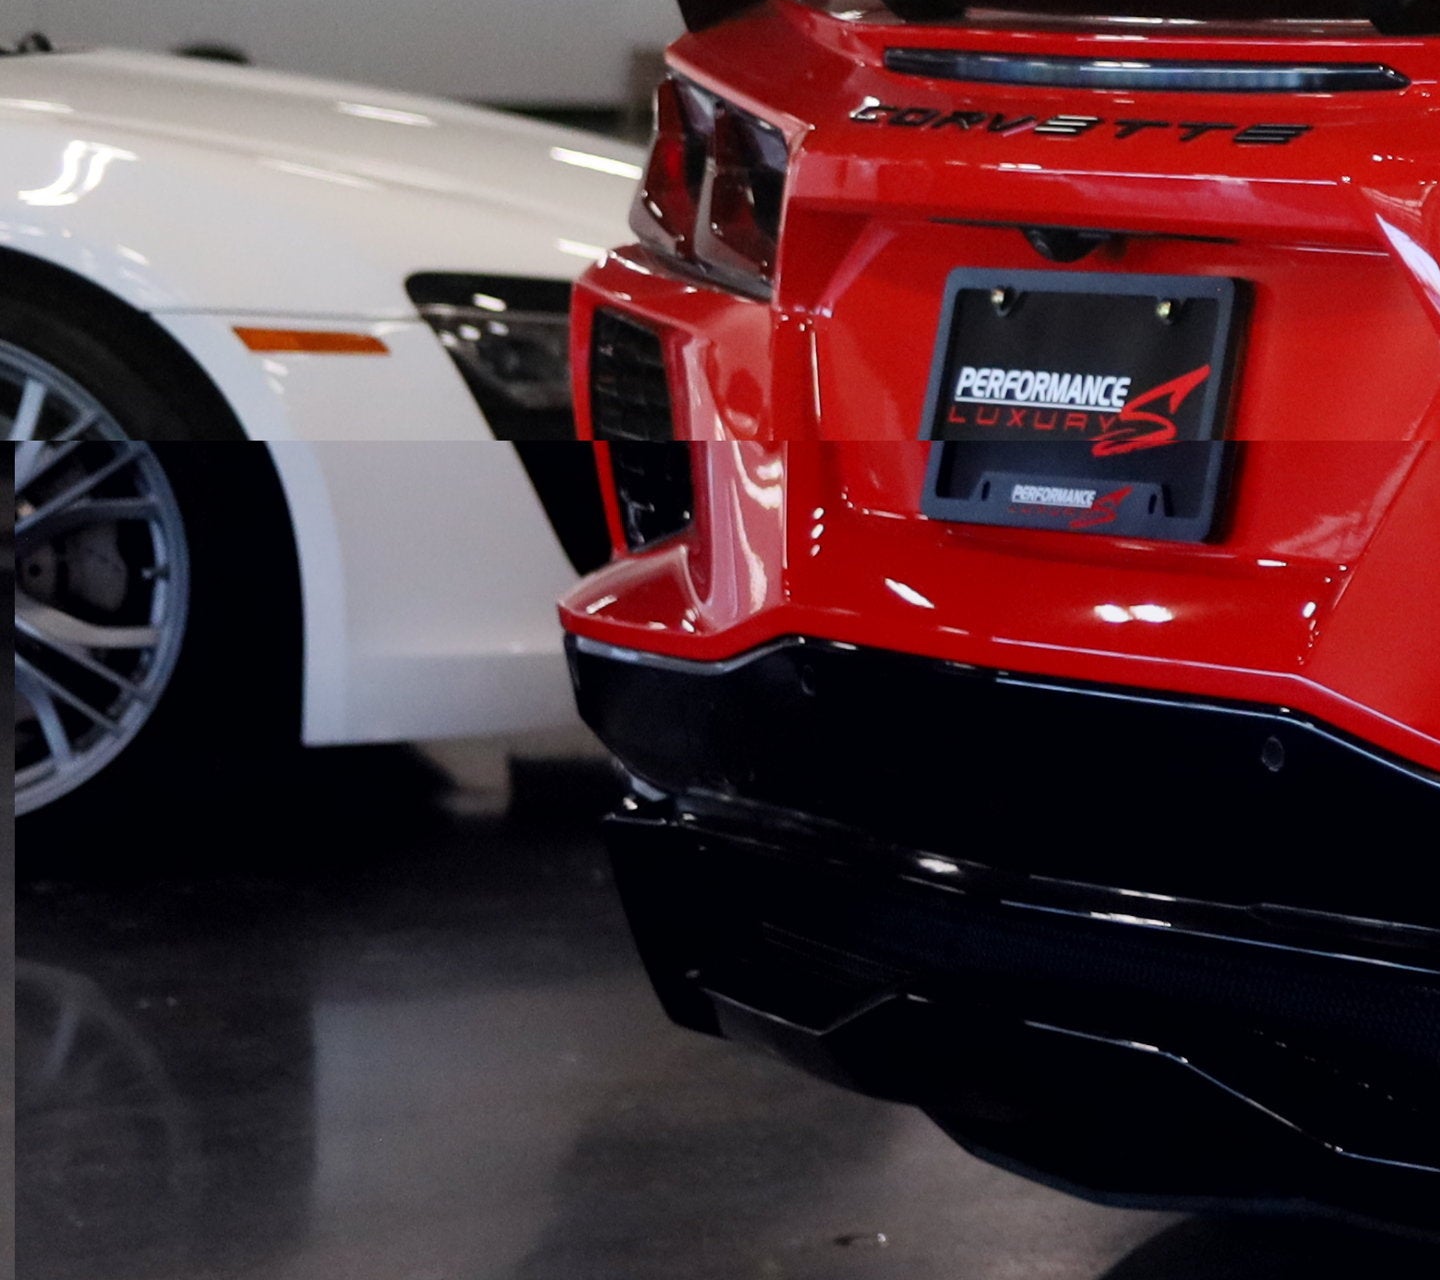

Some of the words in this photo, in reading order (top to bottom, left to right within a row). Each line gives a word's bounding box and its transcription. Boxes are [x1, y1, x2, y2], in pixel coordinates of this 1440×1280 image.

[848, 96, 1314, 144] CORVETTE
[955, 366, 1131, 407] PERFORMANCE
[948, 406, 1115, 433] LUXURY
[1011, 484, 1096, 506] PERFORMANCE
